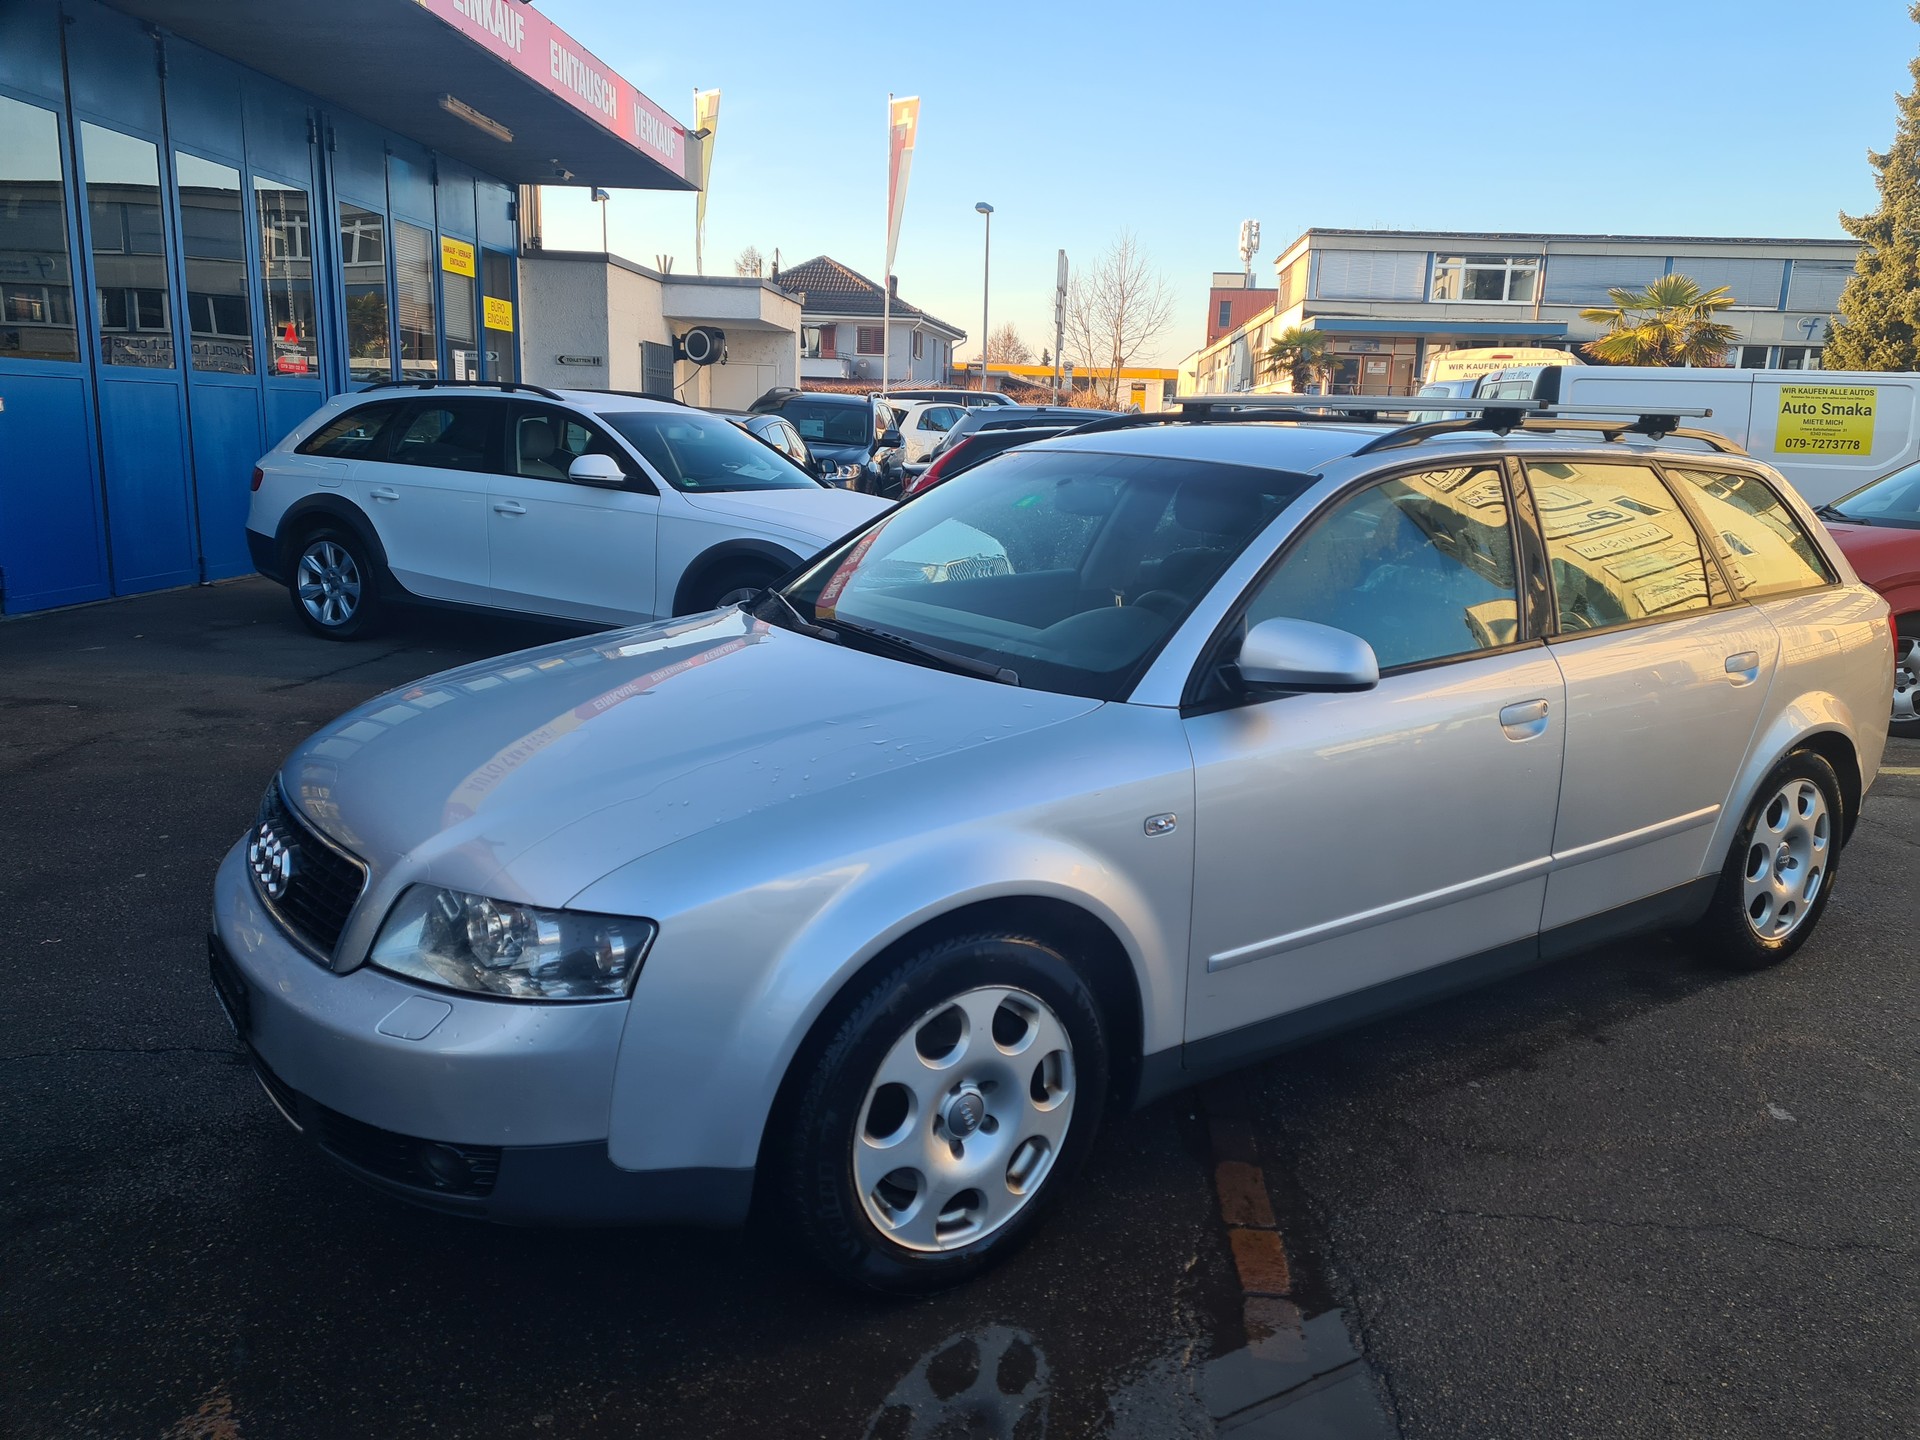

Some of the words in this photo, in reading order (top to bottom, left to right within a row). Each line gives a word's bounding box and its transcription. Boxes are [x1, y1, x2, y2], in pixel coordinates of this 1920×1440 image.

[550, 38, 617, 120] EINTAUSCH
[633, 102, 676, 159] VERKAUF
[490, 300, 506, 314] BÜRO
[487, 313, 510, 326] EINGANG
[1798, 387, 1828, 395] KAUFEN
[1781, 401, 1817, 414] Auto
[1821, 402, 1872, 416] Smaka
[1785, 438, 1860, 450] 079-7273778
